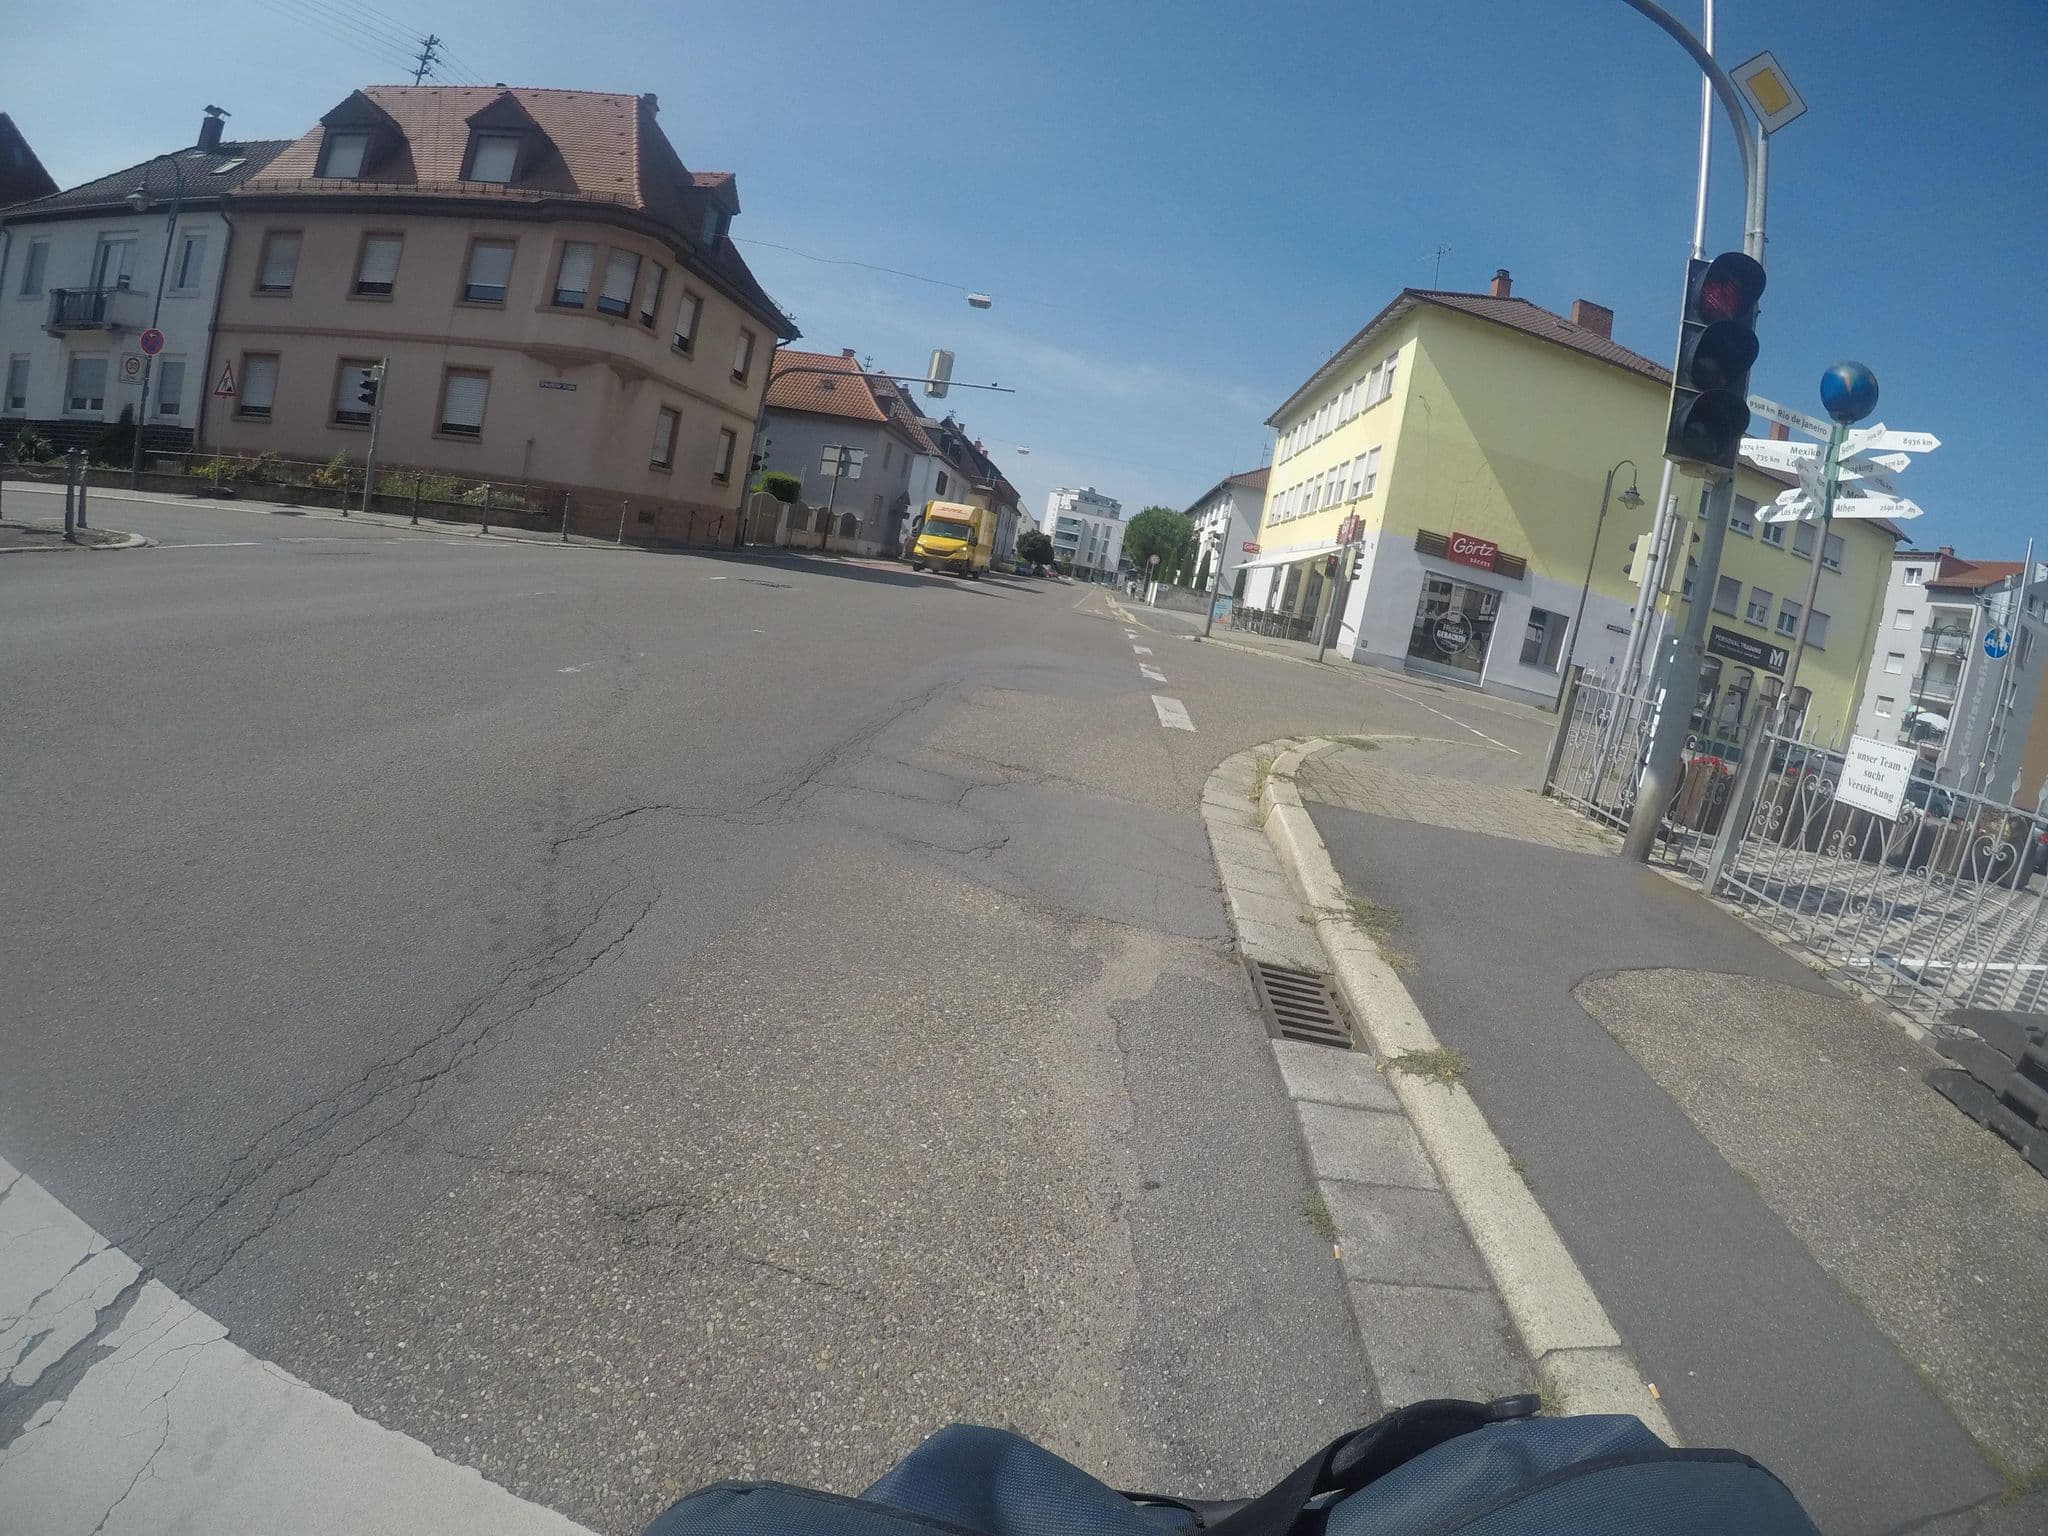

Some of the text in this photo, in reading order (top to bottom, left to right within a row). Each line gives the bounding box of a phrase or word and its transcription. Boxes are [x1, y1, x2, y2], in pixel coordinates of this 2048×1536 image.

[1777, 409, 1790, 420] Rio
[1791, 415, 1801, 425] de
[1801, 418, 1828, 436] Janeiro
[1922, 438, 1933, 446] km
[1790, 446, 1821, 457] Mexiko
[1769, 455, 1780, 463] km
[1781, 508, 1791, 516] Los
[1835, 504, 1856, 513] Athen
[1453, 538, 1494, 556] Görtz
[1856, 751, 1901, 772] unser Team
[1863, 769, 1885, 782] sucht
[1847, 777, 1895, 804] Verstärkung
